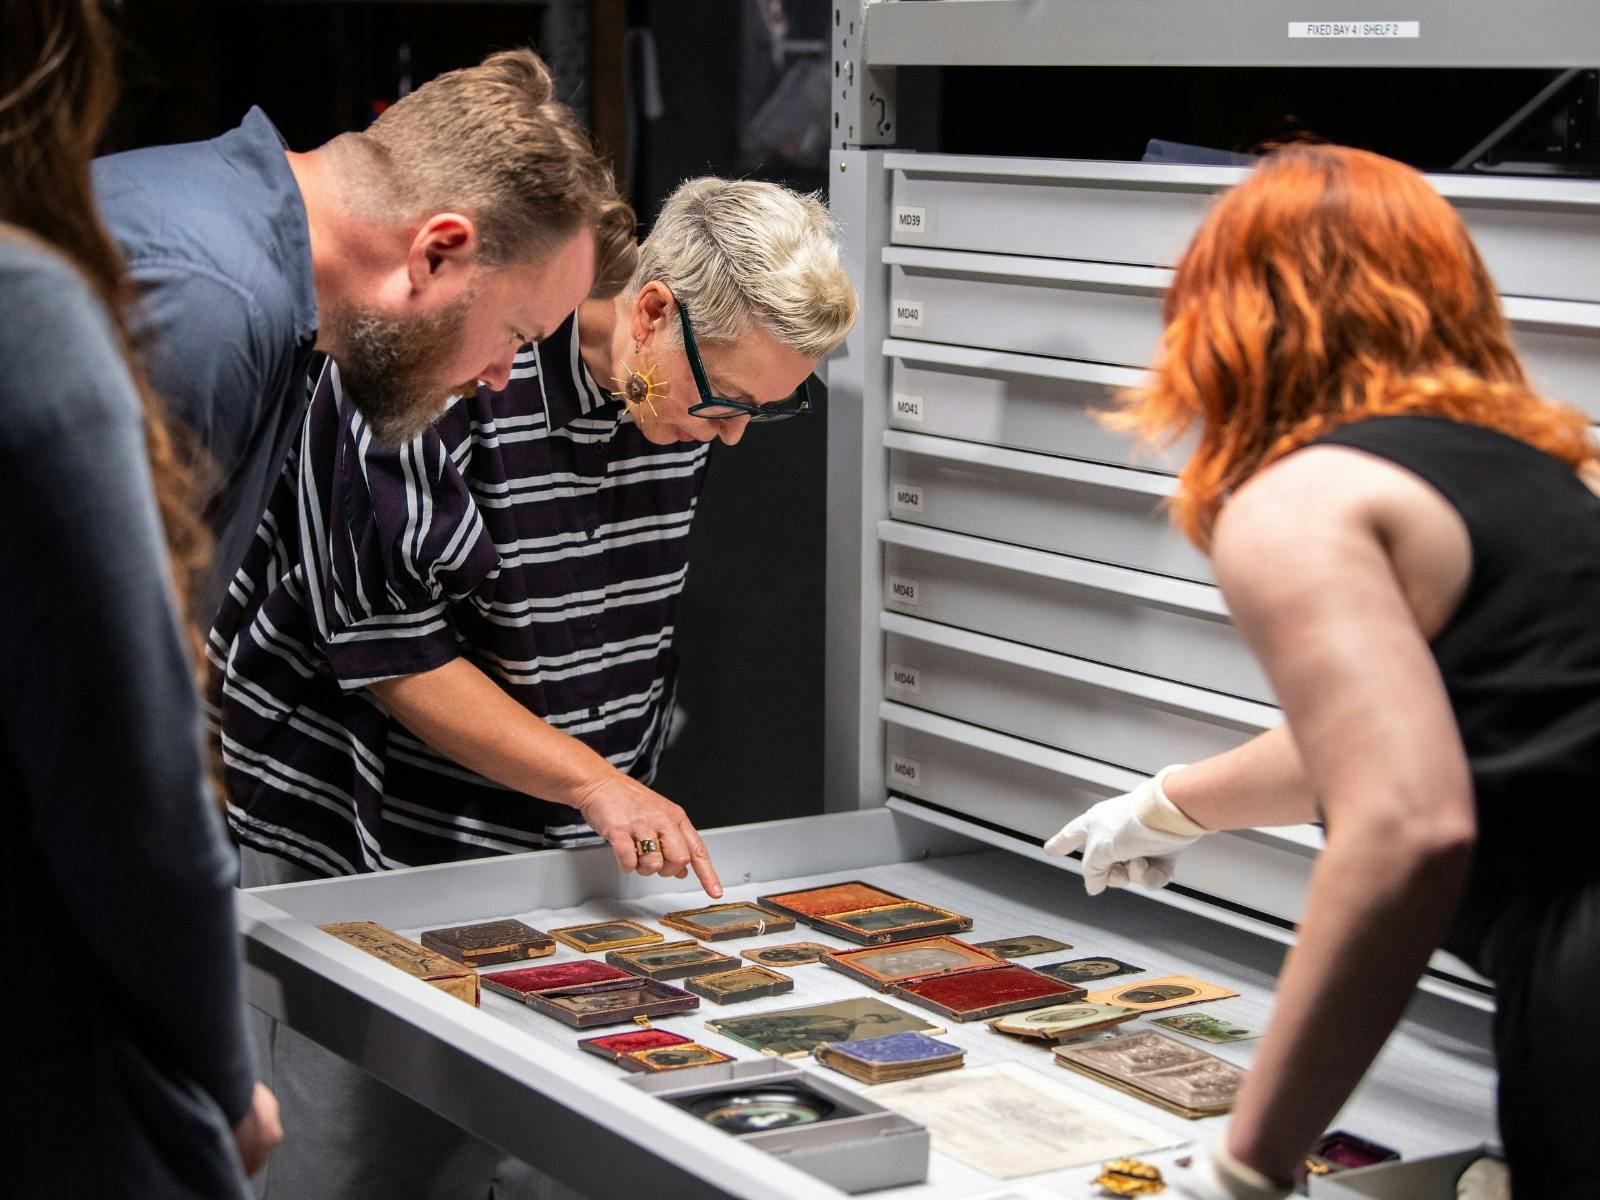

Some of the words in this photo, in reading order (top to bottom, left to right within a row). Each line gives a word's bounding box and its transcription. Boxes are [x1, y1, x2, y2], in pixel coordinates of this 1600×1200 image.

[1307, 24, 1332, 35] FIXED
[1333, 24, 1351, 35] BAY
[1351, 24, 1357, 35] 4
[1364, 24, 1391, 35] SHELF
[1392, 24, 1399, 35] 2
[899, 213, 921, 226] MD39
[897, 307, 919, 320] MD40
[897, 401, 918, 415] MD41
[897, 491, 919, 505] MD42
[893, 583, 914, 598] MD43
[894, 671, 915, 686] MD44
[894, 762, 915, 778] MD45
